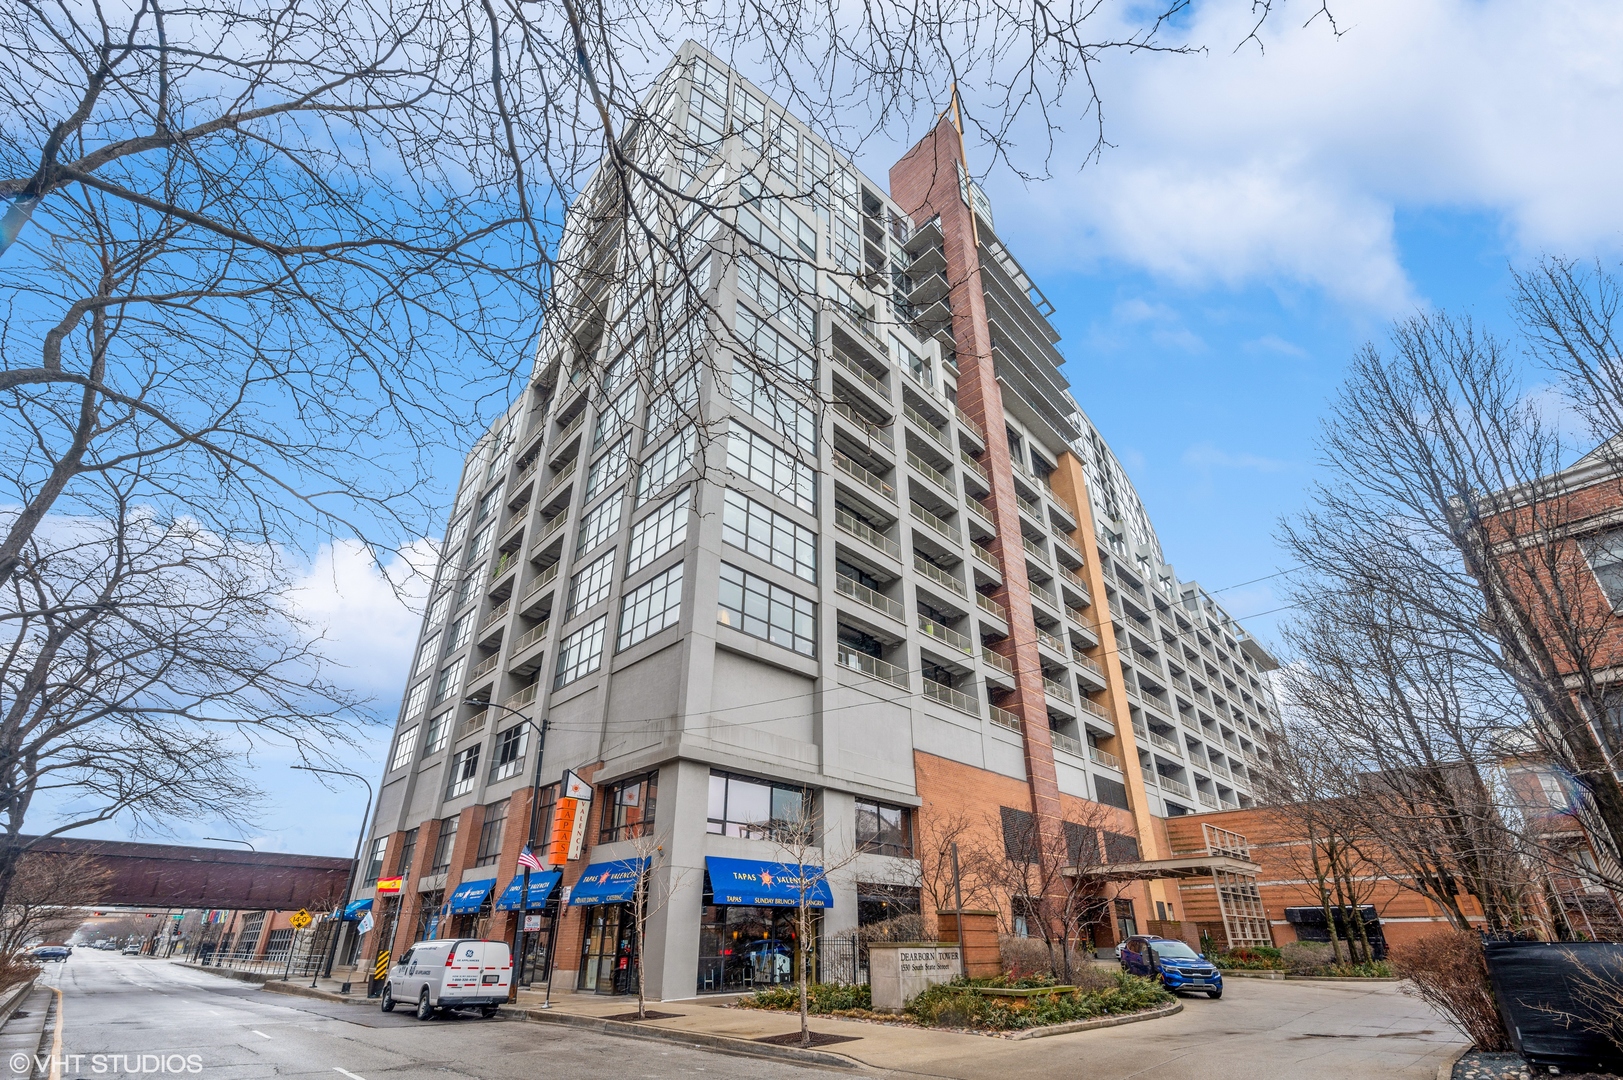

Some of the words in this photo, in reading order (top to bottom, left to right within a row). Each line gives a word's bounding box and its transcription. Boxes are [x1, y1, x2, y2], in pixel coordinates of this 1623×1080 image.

[560, 800, 571, 852] TAPAS
[573, 801, 586, 859] VALENCIA
[582, 875, 599, 883] TAPAS
[610, 871, 637, 880] VALENCIA
[732, 872, 757, 882] TAPAS
[776, 876, 811, 886] VALENIA
[726, 895, 742, 903] TAPAS
[754, 897, 774, 905] SUNDAY
[775, 898, 795, 906] BRUNCH
[805, 899, 825, 907] SANGRIA
[900, 952, 935, 962] DEARBORN
[938, 951, 959, 961] TOWER
[900, 963, 911, 972] 1530
[912, 963, 924, 971] South
[925, 962, 936, 971] State
[937, 961, 950, 970] Street
